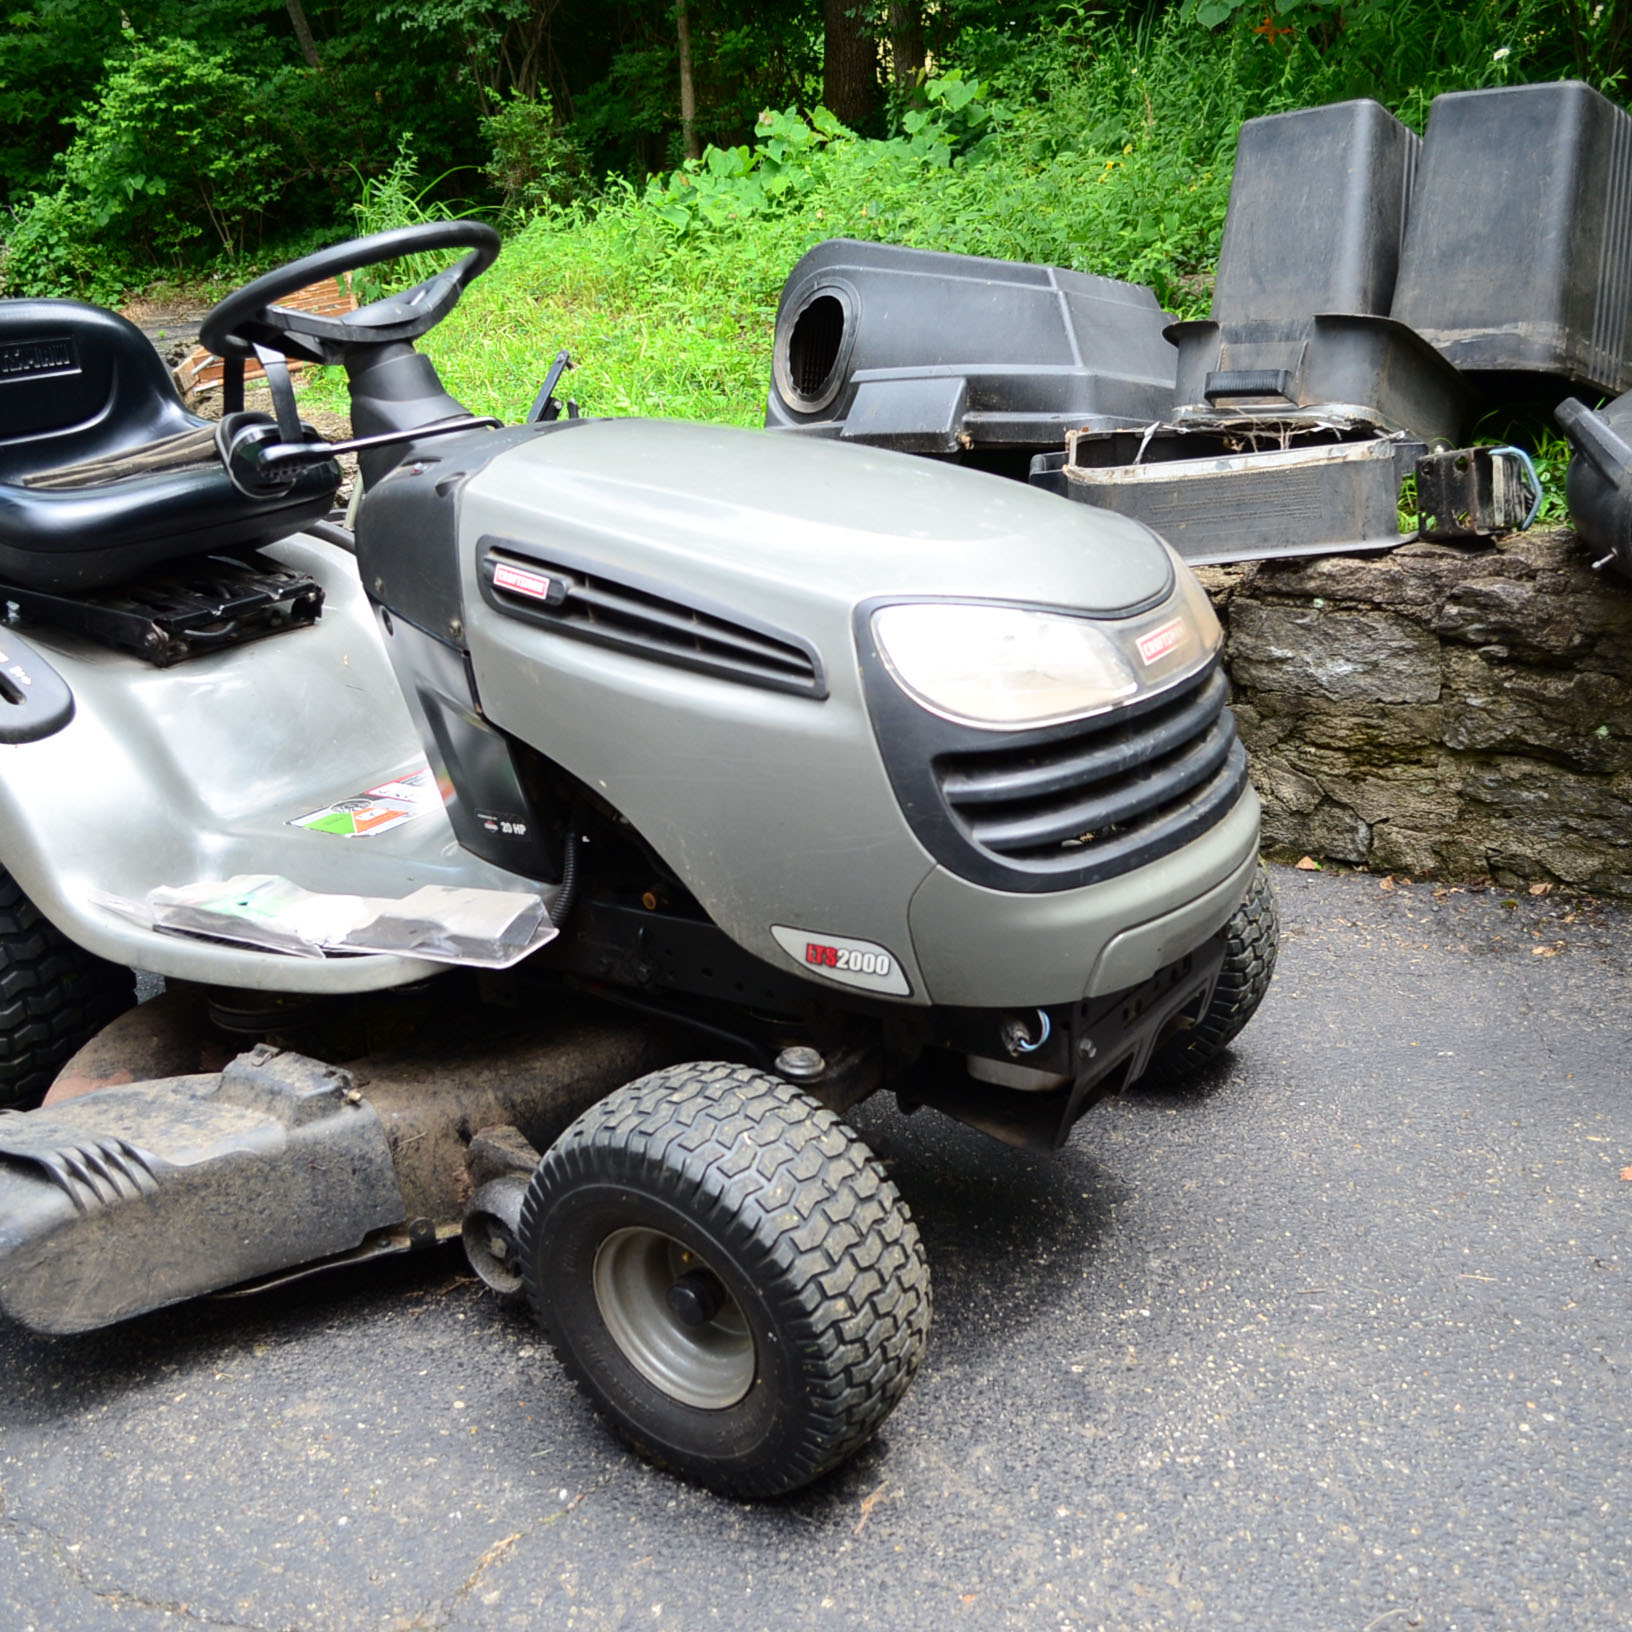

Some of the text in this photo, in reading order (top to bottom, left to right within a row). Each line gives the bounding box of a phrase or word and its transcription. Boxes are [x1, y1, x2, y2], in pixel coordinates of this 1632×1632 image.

[500, 821, 512, 833] 20
[512, 823, 526, 835] HP
[806, 943, 890, 976] LTS2000
